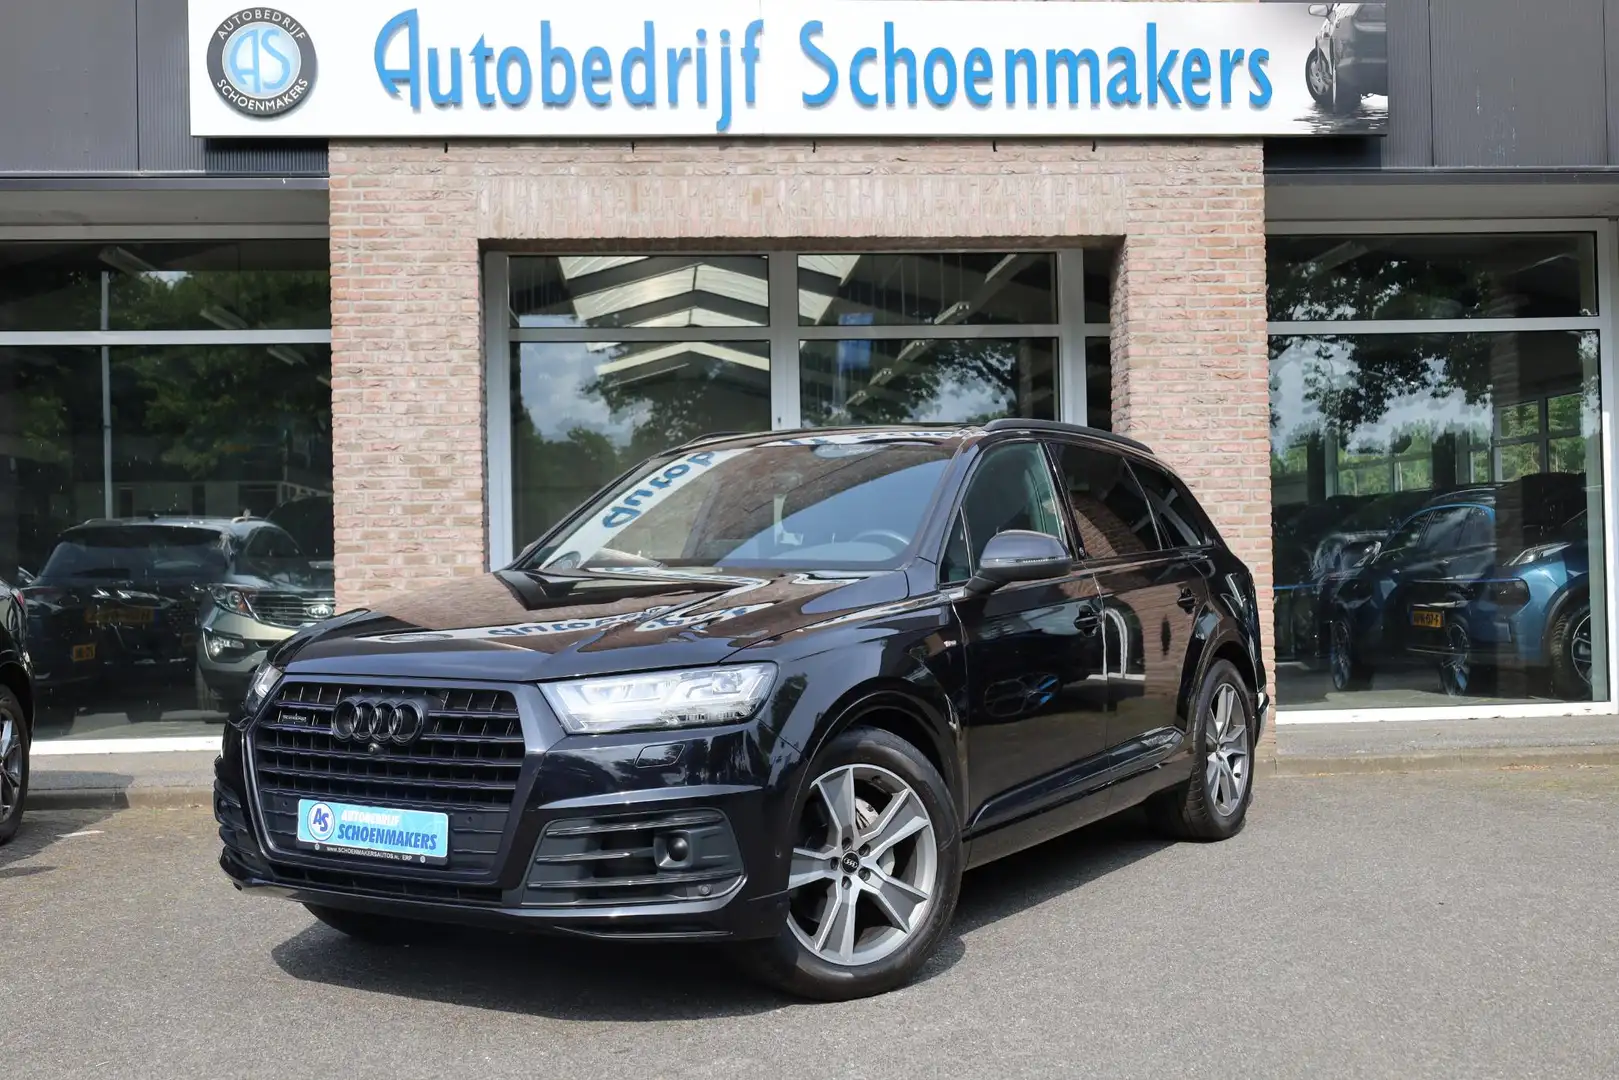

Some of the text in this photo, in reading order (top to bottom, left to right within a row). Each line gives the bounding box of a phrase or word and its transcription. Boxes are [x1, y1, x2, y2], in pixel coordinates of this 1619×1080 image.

[217, 9, 306, 40] AUTOBEDRIJF
[229, 28, 291, 94] AS
[374, 8, 1273, 133] Autobedrijf Schoenmakers
[217, 78, 308, 111] SCHOENMAKERS
[313, 808, 330, 832] AS
[340, 809, 401, 827] AUTOBEDRIJF
[337, 823, 438, 851] SCHOENMAKERS
